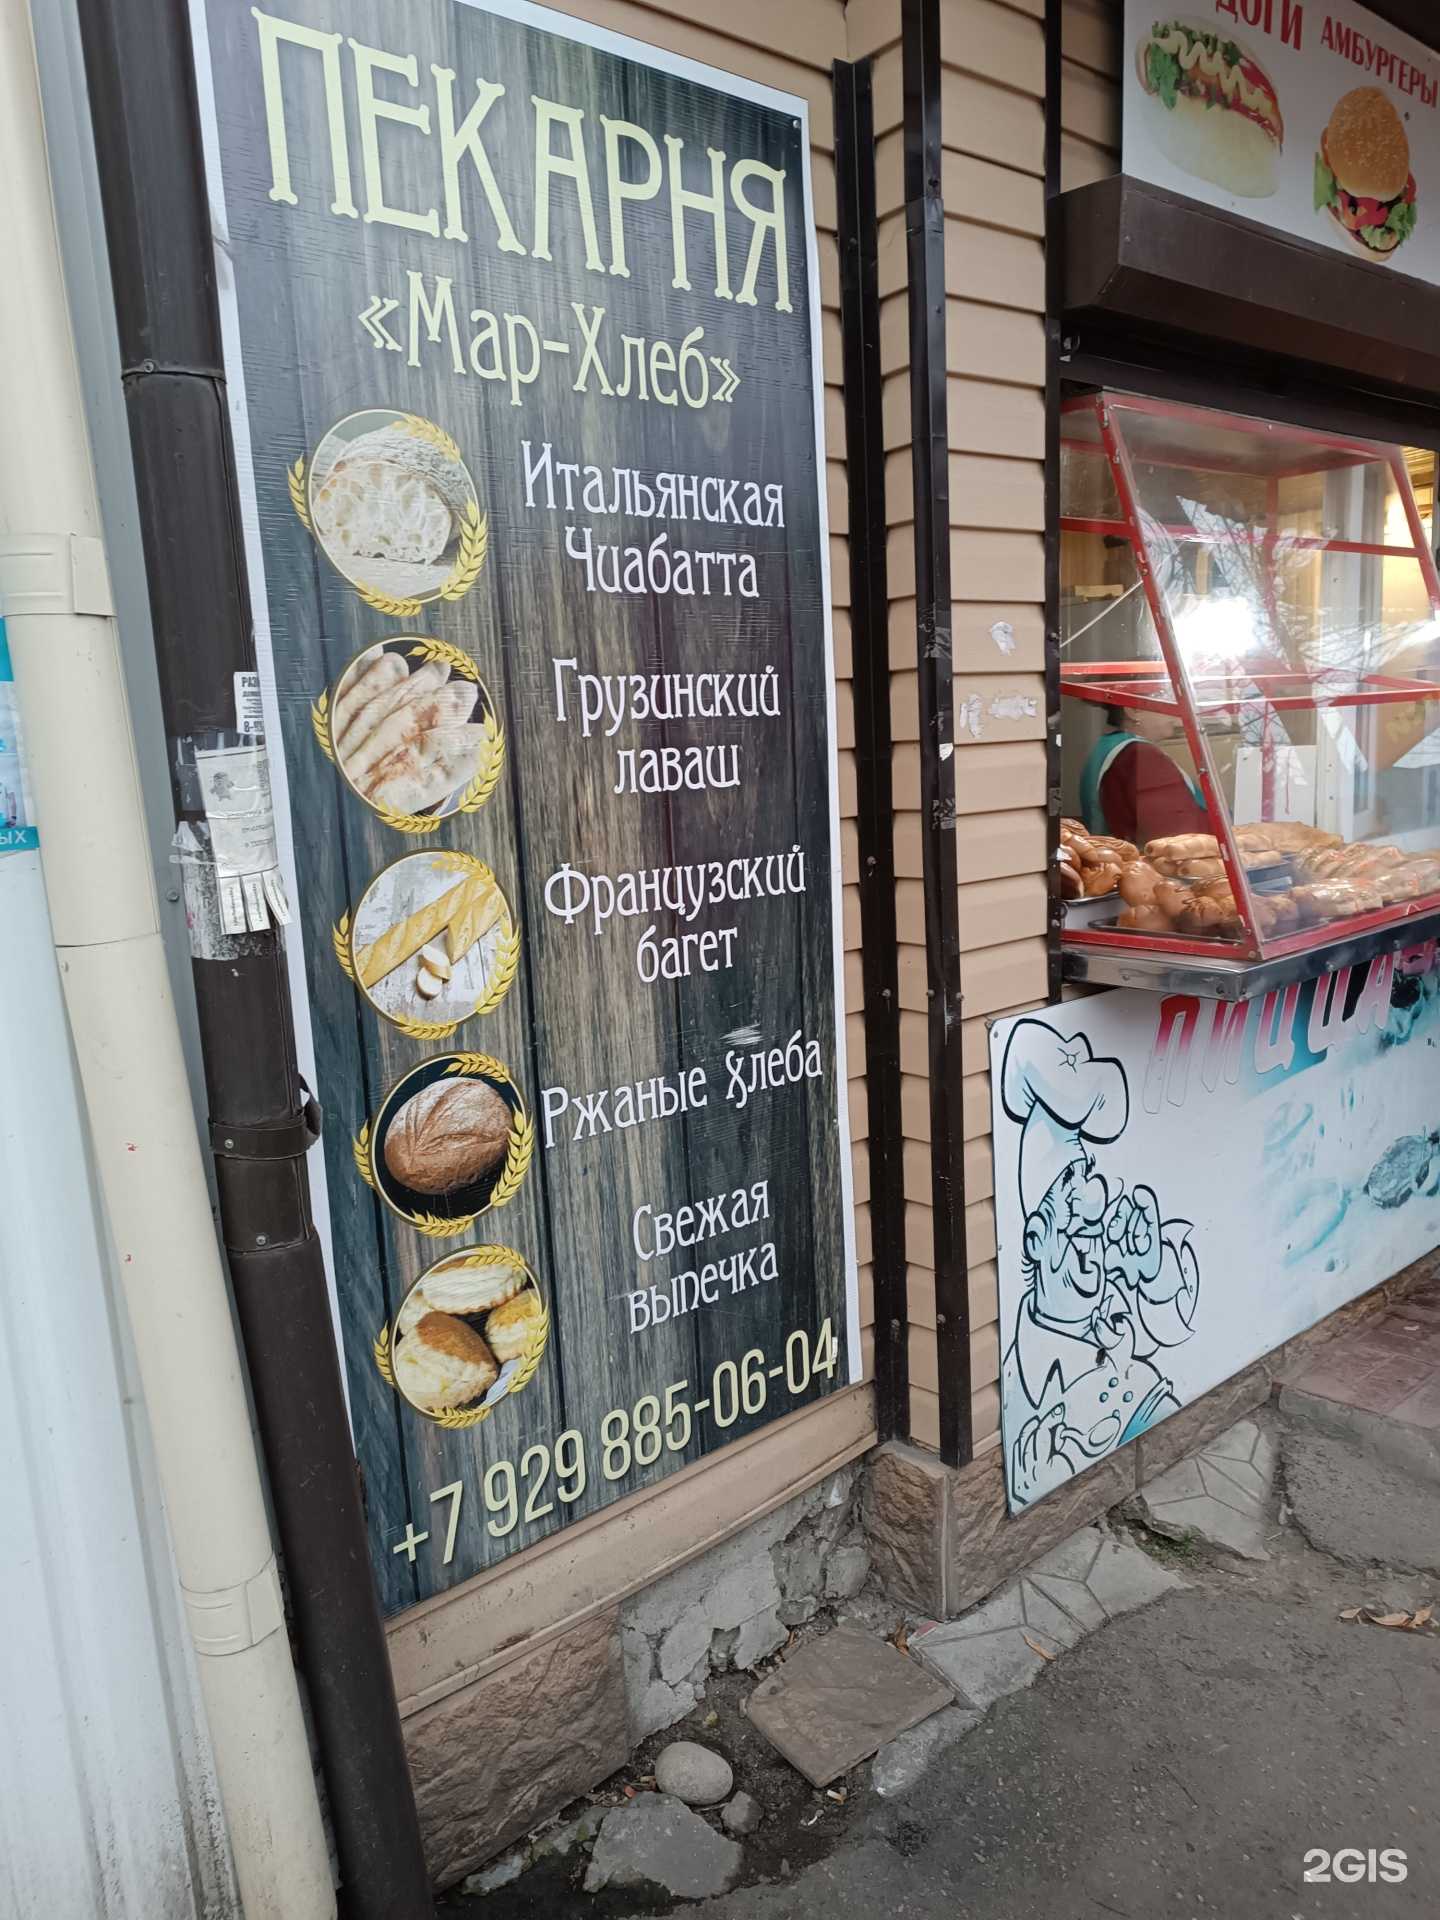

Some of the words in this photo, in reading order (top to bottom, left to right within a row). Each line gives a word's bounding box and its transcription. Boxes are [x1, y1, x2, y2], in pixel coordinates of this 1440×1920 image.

[1320, 15, 1438, 108] АМБУРГЕРЫ
[250, 6, 793, 313] ПЕКАРНЯ
[358, 269, 742, 409] «Мар-Хлеб»
[521, 440, 785, 528] Итальянская
[564, 525, 760, 598] Чиабатта
[552, 658, 781, 737] Грузинский
[613, 743, 741, 794] лаваш
[543, 844, 807, 935] Французский
[635, 926, 739, 983] багет
[1142, 953, 1396, 1115] ПИЦЦА
[541, 1065, 709, 1149] Ржаные
[631, 1179, 771, 1262] Свежая
[628, 1241, 779, 1335] выпечка
[392, 1479, 464, 1566] +7
[482, 1429, 588, 1538] 929
[601, 1317, 839, 1482] 885-06-04
